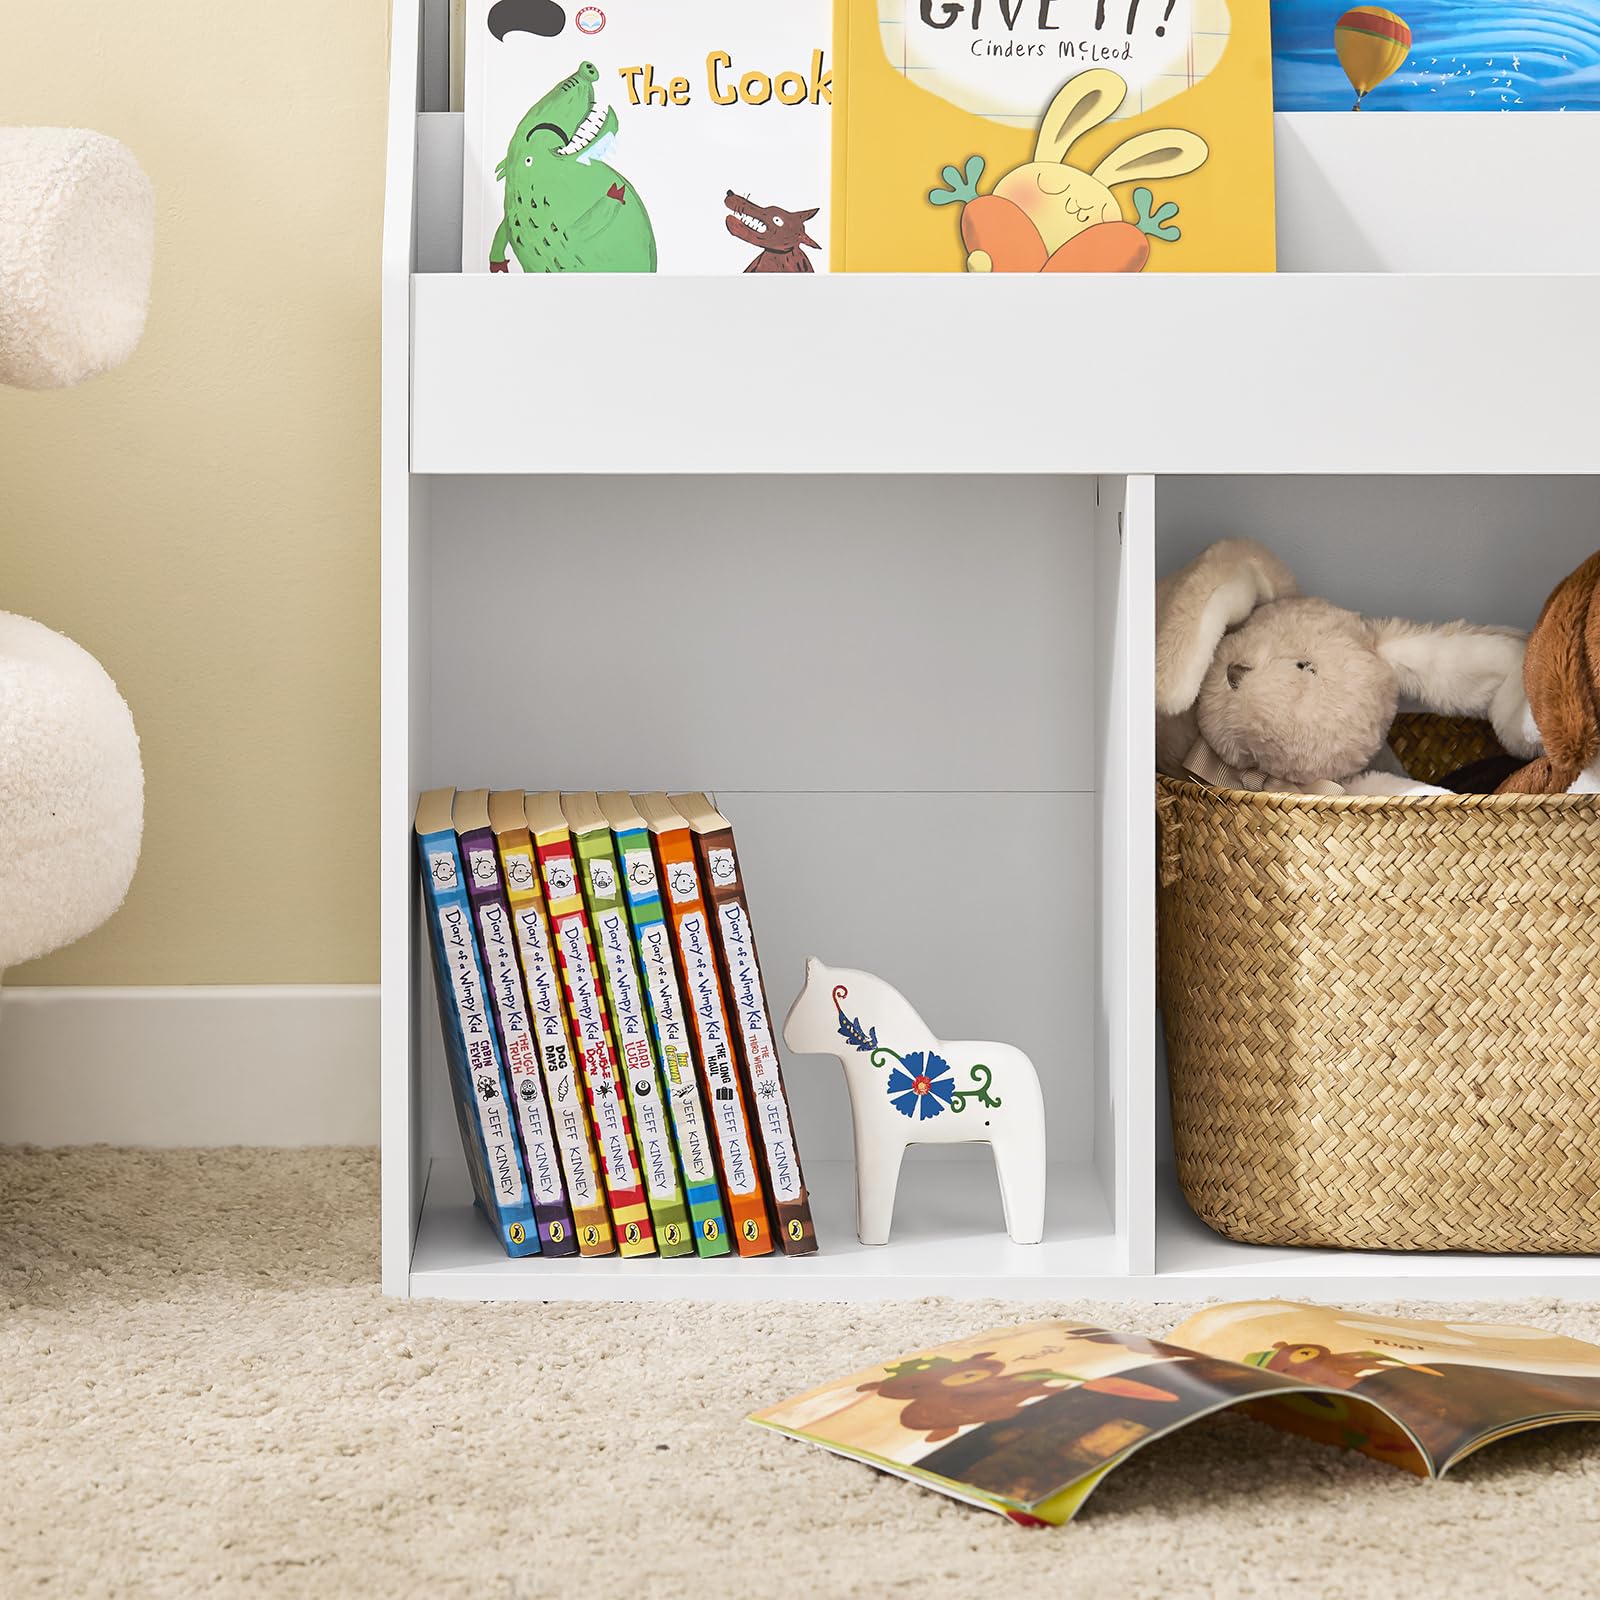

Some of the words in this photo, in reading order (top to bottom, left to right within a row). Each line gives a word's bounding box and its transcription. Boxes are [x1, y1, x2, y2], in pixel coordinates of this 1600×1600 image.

[971, 38, 1046, 57] Cinders
[618, 63, 691, 107] The
[446, 910, 465, 947] Diary
[486, 908, 505, 944] Diary
[522, 912, 541, 948] Diary
[604, 916, 622, 951] Diary
[685, 919, 703, 955] Diary
[725, 907, 744, 943] Diary
[458, 951, 468, 960] of
[499, 948, 508, 958] of
[534, 952, 544, 962] of
[565, 927, 582, 960] Diary
[648, 932, 664, 964] Diary
[737, 947, 747, 957] of
[576, 964, 585, 973] of
[616, 955, 625, 964] of
[658, 967, 666, 976] of
[697, 959, 706, 968] of
[459, 971, 475, 1011] Wimpy
[500, 969, 516, 1009] Wimpy
[536, 972, 550, 1013] Wimpy
[578, 982, 592, 1020] Wimpy
[617, 974, 631, 1013] Wimpy
[698, 979, 712, 1019] Wimpy
[739, 967, 754, 1008] Wimpy
[659, 985, 672, 1021] Wimpy
[467, 1014, 483, 1033] Kid
[508, 1011, 522, 1031] Kid
[543, 1015, 558, 1035] Kid
[585, 1022, 599, 1040] Kid
[624, 1015, 638, 1034] Kid
[666, 1023, 679, 1039] Kid
[706, 1021, 720, 1040] Kid
[747, 1011, 761, 1030] Kid
[469, 1042, 482, 1071] FEVER
[480, 1040, 493, 1067] CABIN
[509, 1042, 523, 1074] TRUTH
[518, 1033, 528, 1050] THE
[523, 1051, 536, 1075] UGLY
[545, 1046, 557, 1071] DAYS
[555, 1045, 568, 1069] DOG
[625, 1042, 639, 1069] LUCK
[636, 1040, 650, 1068] HARD
[715, 1043, 726, 1059] THE
[749, 1035, 758, 1054] THIRD
[761, 1046, 769, 1059] THE
[585, 1049, 598, 1076] DOWN
[595, 1041, 611, 1079] DOUBLE
[665, 1045, 681, 1084] GETAWAY
[677, 1052, 689, 1067] THE
[708, 1056, 719, 1076] HAUL
[719, 1062, 731, 1083] LONG
[562, 1110, 578, 1140] JEFF
[642, 1105, 657, 1133] JEFF
[683, 1099, 696, 1125] JEFF
[723, 1103, 737, 1132] JEFF
[767, 1104, 782, 1134] JEFF
[487, 1107, 503, 1137] JEFF
[495, 1145, 514, 1196] KINNEY
[527, 1106, 542, 1136] JEFF
[535, 1143, 553, 1194] KINNEY
[603, 1102, 617, 1129] JEFF
[610, 1135, 627, 1182] KINNEY
[689, 1131, 705, 1175] KINNEY
[569, 1147, 589, 1198] KINNEY
[649, 1140, 667, 1189] KINNEY
[729, 1139, 747, 1188] KINNEY
[774, 1142, 792, 1193] KINNEY
